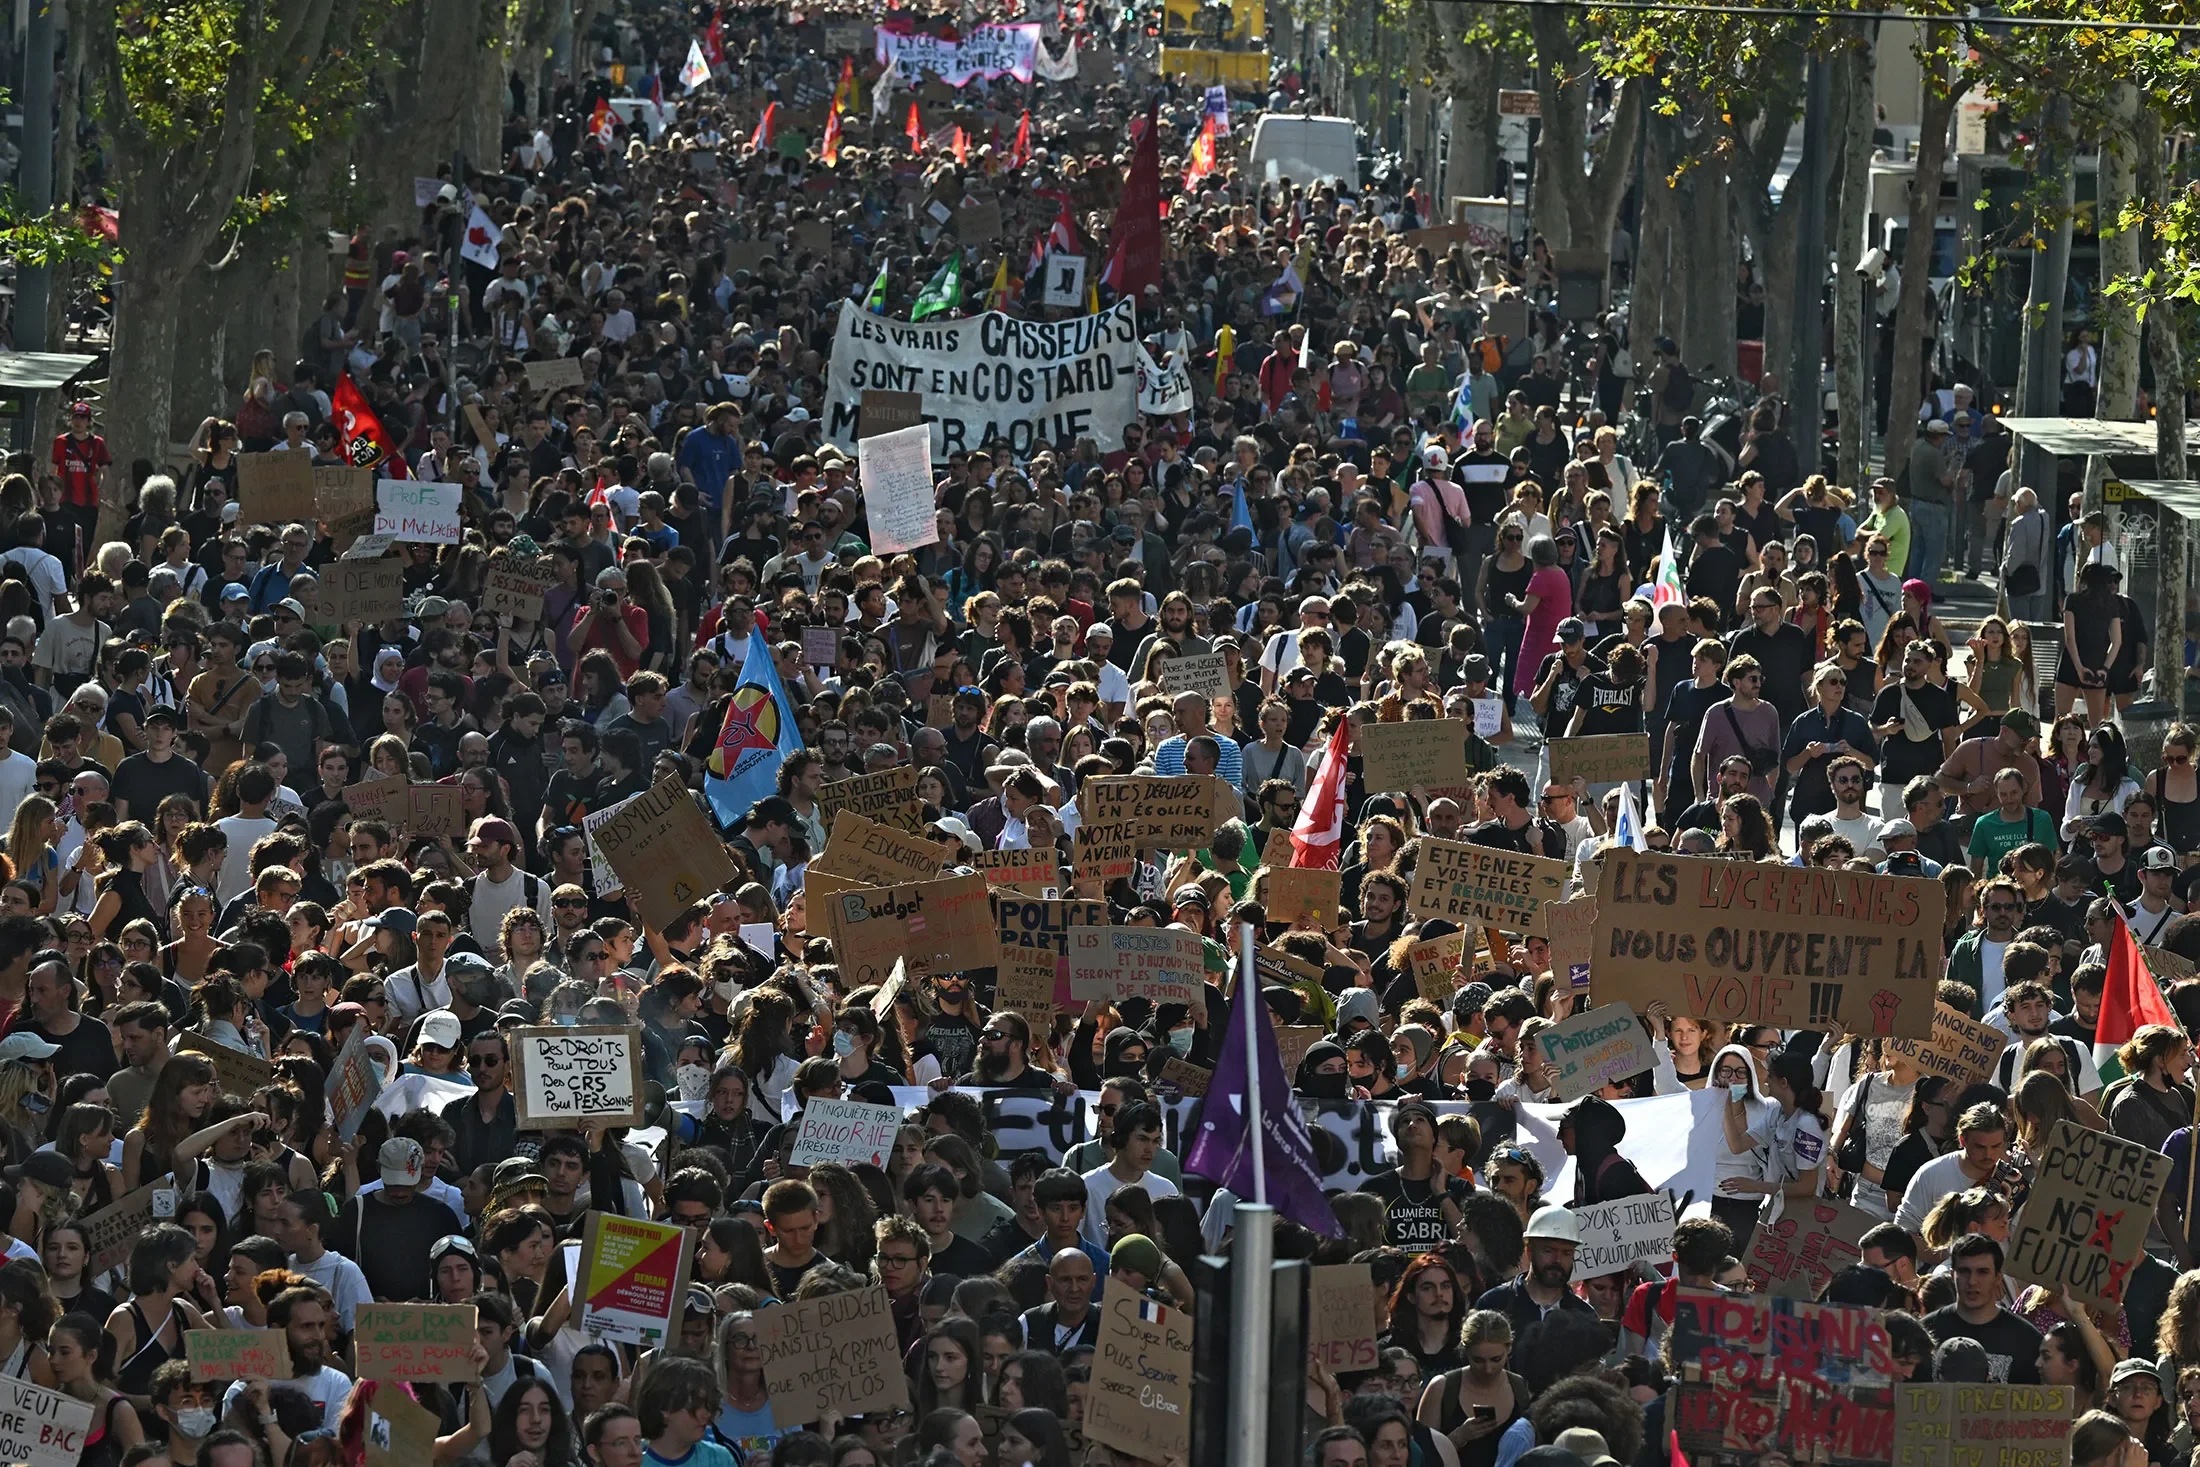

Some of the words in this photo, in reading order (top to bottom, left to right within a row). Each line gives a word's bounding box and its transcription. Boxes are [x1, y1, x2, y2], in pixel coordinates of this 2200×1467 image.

[851, 317, 887, 344] LES
[894, 327, 960, 351] VRAIS
[981, 300, 1136, 361] CASSEURS
[850, 359, 924, 393] SONT
[932, 369, 968, 395] EN
[2107, 487, 2122, 495] T2
[377, 517, 396, 531] DU
[344, 571, 369, 593] DE
[492, 574, 511, 588] DES
[513, 579, 545, 598] JEUNES
[1592, 685, 1635, 708] EVERLAST
[1367, 726, 1391, 738] LES
[1372, 737, 1413, 751] VISENT
[1416, 736, 1427, 745] LE
[1556, 739, 1621, 756] TOUCHEZ
[1625, 737, 1645, 749] PAS
[1369, 752, 1387, 764] LA
[1391, 750, 1413, 761] BAC
[1416, 749, 1441, 759] VISE
[1572, 759, 1601, 773] NOS
[821, 784, 847, 801] ILS
[846, 773, 897, 796] VEULENT
[1095, 783, 1140, 803] FLICS
[1144, 780, 1203, 801] DÉGUISÉS
[601, 779, 687, 852] BISMILLAH
[1098, 805, 1121, 818] EN
[1133, 802, 1210, 819] ÉCOLIERS
[416, 815, 450, 834] 2027
[657, 820, 673, 836] LES
[1078, 820, 1137, 847] NOTRE
[1147, 824, 1163, 836] DE
[1034, 851, 1048, 862] EN
[1081, 841, 1132, 863] AVENIR
[1437, 866, 1469, 883] VOS
[1612, 861, 1678, 905] LES
[1419, 895, 1441, 910] LA
[1424, 877, 1448, 891] ET
[1451, 882, 1539, 912] REGARDEZ
[842, 891, 923, 924] Budget
[1077, 934, 1099, 948] LES
[1111, 932, 1172, 951] RACISTES
[1002, 947, 1033, 961] MAI
[1034, 951, 1054, 967] 68
[1118, 953, 1132, 966] ET
[1413, 945, 1440, 962] NOUS
[1610, 926, 1697, 963] NOUS
[1704, 926, 1882, 978] OUVRENT
[1894, 937, 1928, 980] LA
[1038, 968, 1054, 978] PAS
[1075, 967, 1123, 980] SERONT
[1130, 967, 1150, 980] LES
[1420, 962, 1438, 977] LA
[1116, 983, 1135, 996] DE
[1143, 984, 1192, 999] DEMAIN
[1003, 999, 1027, 1009] DANS
[1032, 1001, 1050, 1010] NOS
[925, 1024, 976, 1045] METALLICA
[1977, 1031, 2000, 1053] NOS
[536, 1038, 563, 1056] Des
[561, 1038, 625, 1057] DROITS
[1890, 1037, 1919, 1057] VOUS
[544, 1056, 573, 1071] Pour
[573, 1058, 618, 1072] TOUS
[1958, 1044, 1989, 1071] POUR
[541, 1073, 565, 1087] Des
[568, 1075, 607, 1092] CRS
[545, 1090, 571, 1111] Pour
[572, 1091, 633, 1110] PERSONNE
[809, 1099, 871, 1120] T'INQUIÈTE
[875, 1110, 896, 1123] PAS
[794, 1139, 825, 1152] APRÈS
[825, 1142, 840, 1154] LES
[2061, 1124, 2161, 1180] VOTRE
[2042, 1146, 2159, 1207] POLITIQUE
[1390, 1205, 1439, 1219] LUMIÈRE
[1623, 1199, 1673, 1226] JEUNES
[606, 1222, 662, 1241] AUJOURD'HUI
[1612, 1228, 1623, 1242] &
[617, 1243, 633, 1251] VOUS
[1573, 1236, 1675, 1274] RÉVOLUTIONNAIRES
[634, 1272, 668, 1288] DEMAIN
[616, 1288, 664, 1303] DÉBROUILLEREZ
[630, 1284, 647, 1292] VOUS
[648, 1287, 665, 1296] VOUS
[629, 1298, 646, 1306] TOUT
[375, 1311, 415, 1326] PROF
[423, 1311, 465, 1329] POUR
[782, 1307, 813, 1338] DE
[818, 1286, 886, 1328] BUDGET
[1111, 1299, 1160, 1350] Soyez
[190, 1332, 260, 1348] TOUJOURS
[1677, 1294, 1800, 1350] TOUS
[1803, 1306, 1893, 1376] UNIS
[241, 1347, 275, 1362] MAIS
[359, 1345, 373, 1363] 5
[380, 1345, 414, 1360] CRS
[423, 1345, 467, 1360] POUR
[760, 1337, 804, 1366] DANS
[805, 1332, 833, 1353] LES
[814, 1333, 896, 1372] LACRYMO
[200, 1363, 225, 1377] PAS
[228, 1361, 274, 1377] FACHO
[768, 1378, 796, 1395] QUE
[800, 1367, 842, 1389] POUR
[850, 1357, 878, 1378] LES
[1699, 1346, 1833, 1400] POUR
[816, 1373, 885, 1410] STYLOS
[1905, 1387, 1941, 1415] TU
[1958, 1386, 2064, 1414] PRENDS
[14, 1386, 64, 1419] VEUT
[39, 1423, 76, 1452] BAC
[1904, 1420, 1950, 1441] TON
[1959, 1418, 2072, 1441] PARCOURSUP
[1902, 1445, 1937, 1467] ET
[1952, 1445, 1984, 1467] TU
[2000, 1446, 2063, 1467] HORS
